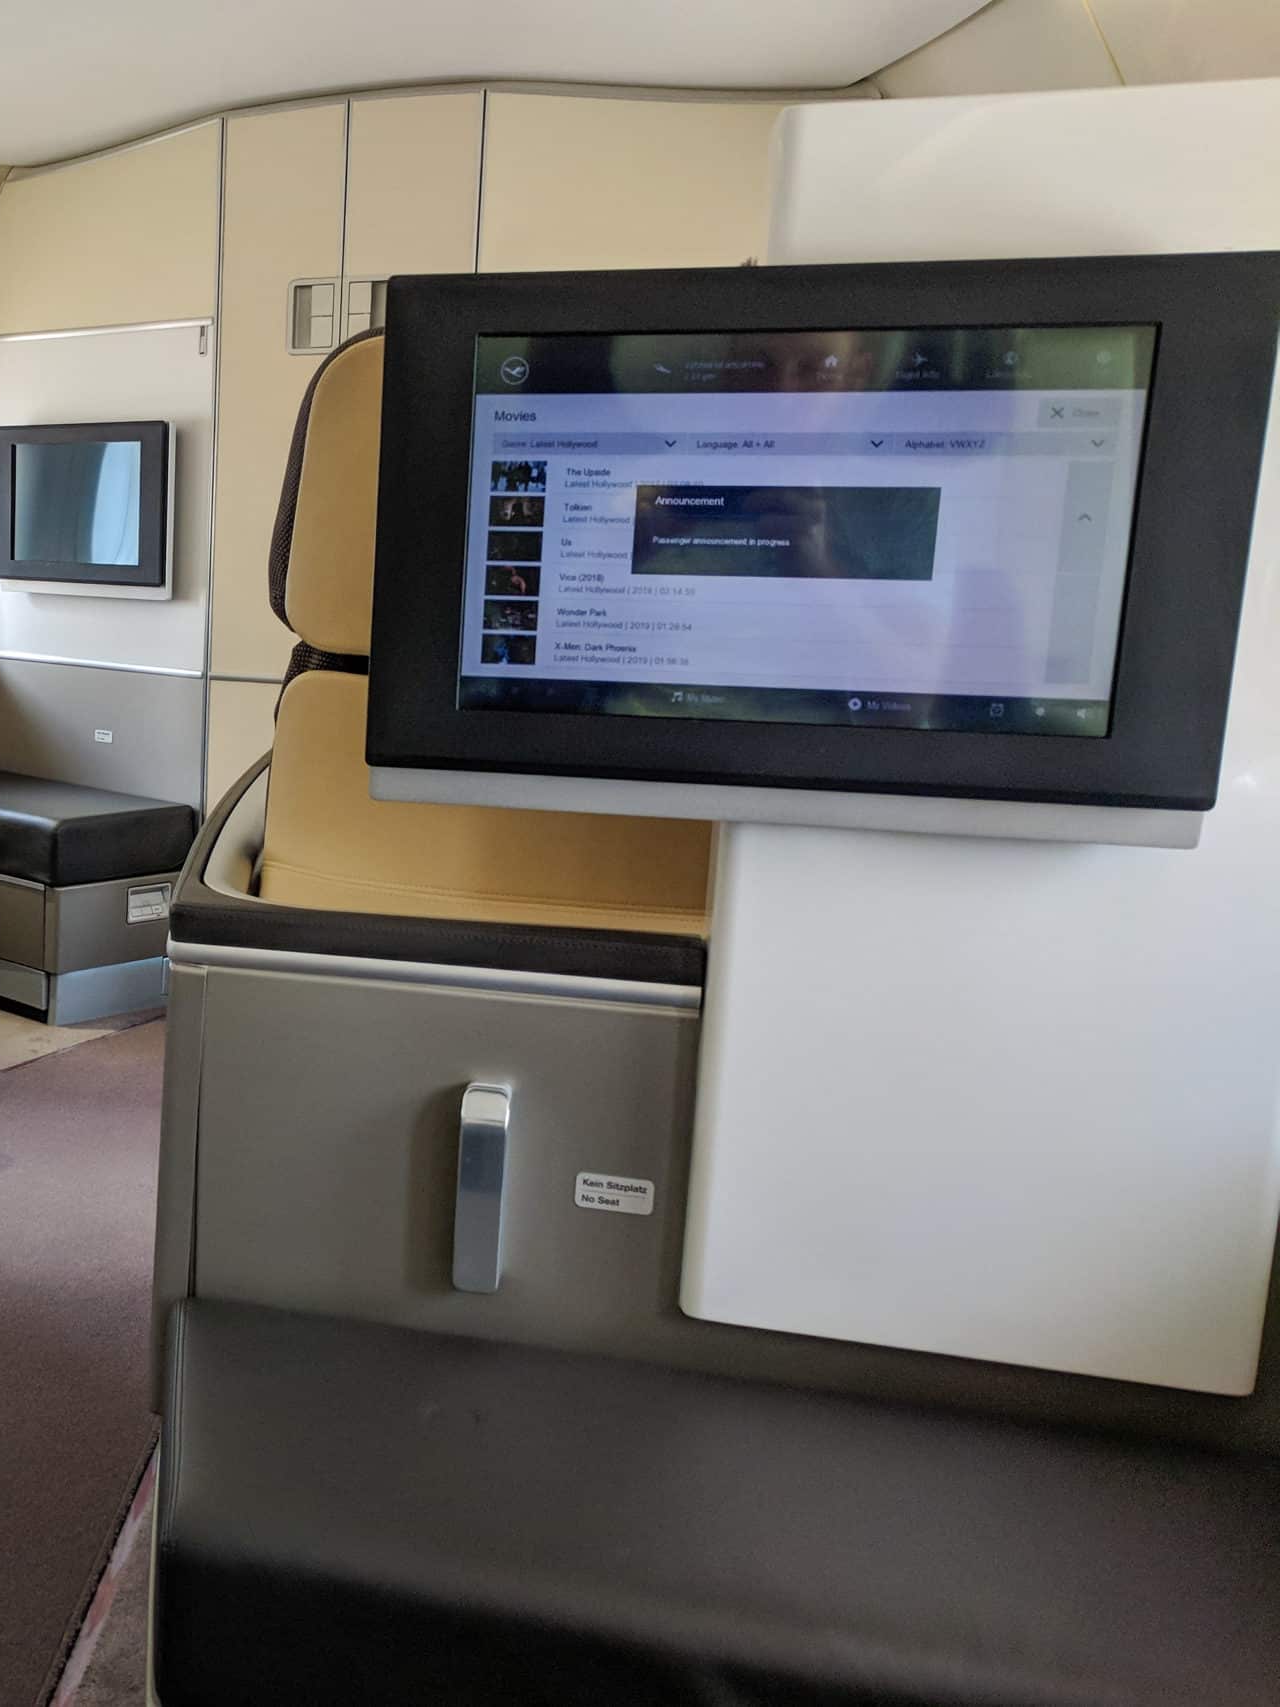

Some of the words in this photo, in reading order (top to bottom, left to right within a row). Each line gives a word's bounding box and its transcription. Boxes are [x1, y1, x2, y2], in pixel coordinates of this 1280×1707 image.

[494, 410, 537, 422] Movies
[530, 439, 556, 449] Latest
[557, 439, 598, 451] Hollywood
[950, 440, 986, 449] VWXYZ
[567, 467, 582, 477] The
[564, 479, 591, 488] Latest
[591, 480, 633, 490] Hollywood
[655, 495, 725, 507] Announcement
[562, 515, 588, 524] Latest
[589, 516, 631, 526] Hollywood
[561, 538, 572, 547] Us
[652, 536, 692, 547] Passenger
[692, 536, 748, 546] announcement
[749, 537, 756, 546] in
[757, 538, 790, 548] progress
[560, 550, 586, 559] Latest
[587, 551, 628, 561] Hollywood
[559, 573, 577, 582] Vice
[558, 585, 583, 594] Latest
[584, 585, 625, 596] Hollywood
[557, 608, 587, 617] Wonder
[589, 608, 607, 617] Park
[556, 620, 581, 629] Latest
[582, 620, 623, 631] Hollywood
[630, 622, 650, 631] 2019
[584, 642, 603, 651] Dark
[605, 643, 637, 653] Phoenix
[554, 654, 579, 664] Latest
[580, 655, 621, 666] Hollywood
[627, 656, 648, 665] 2019
[582, 1178, 604, 1189] Kein
[605, 1181, 648, 1194] Sitzplatz
[581, 1194, 595, 1203] No
[598, 1196, 620, 1207] Seat
